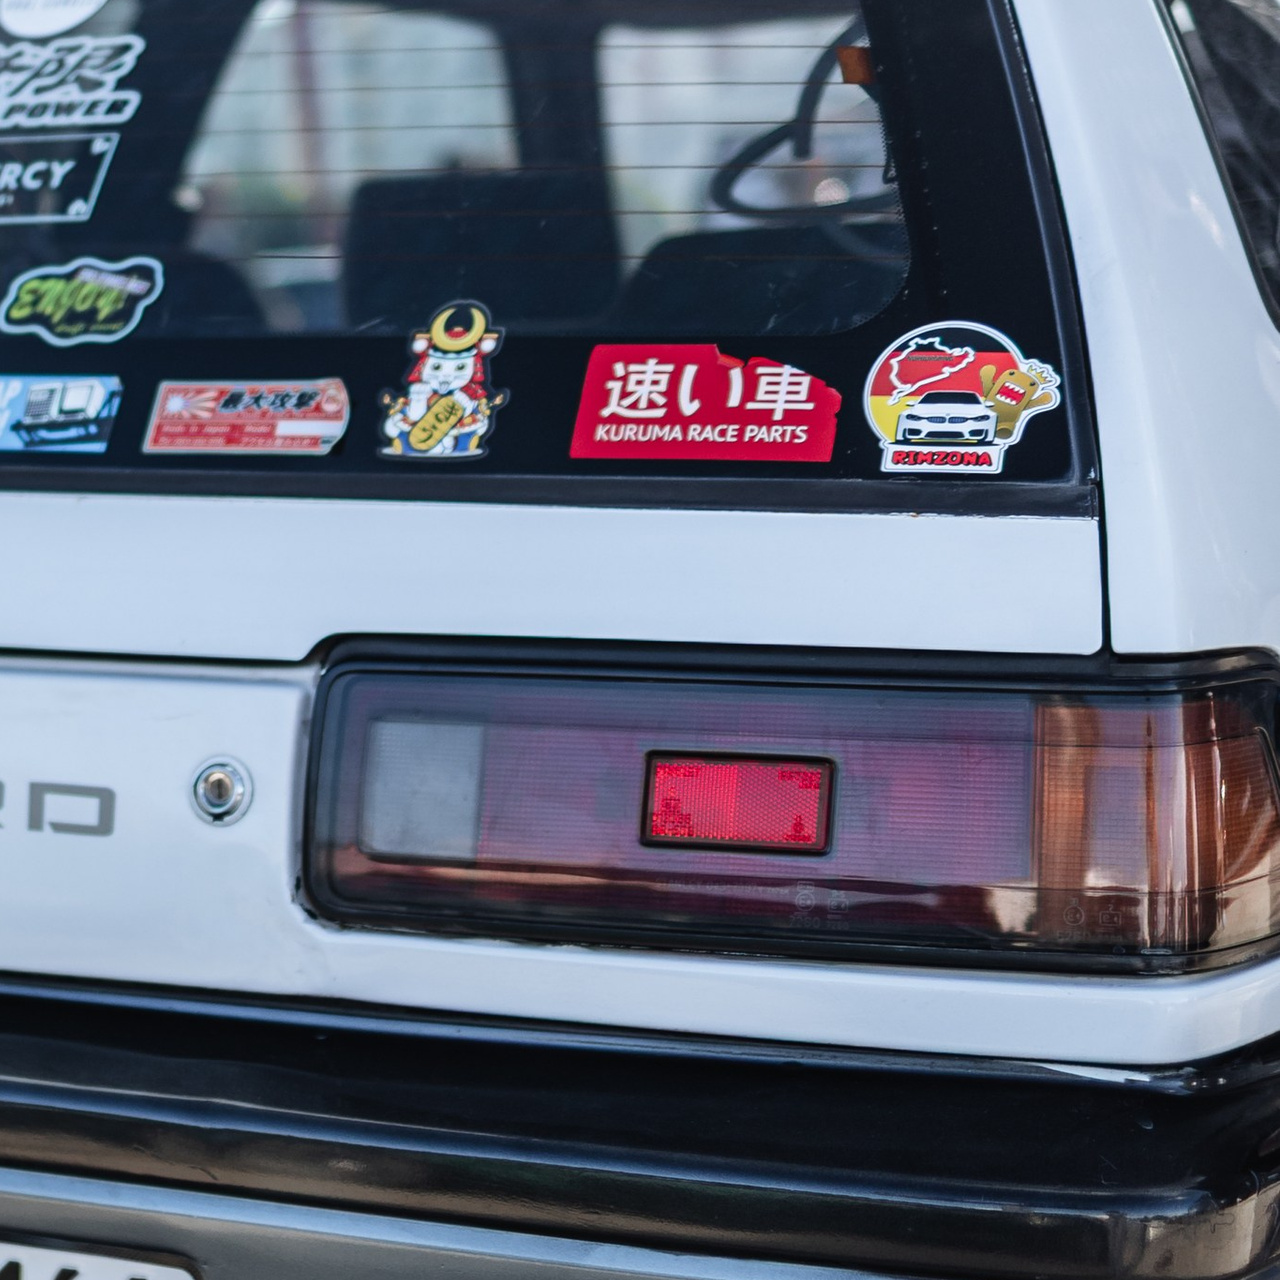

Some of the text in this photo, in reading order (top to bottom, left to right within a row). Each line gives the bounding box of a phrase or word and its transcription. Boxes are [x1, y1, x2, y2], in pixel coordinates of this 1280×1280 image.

[1, 98, 132, 120] POWER
[598, 357, 816, 422] 速い車
[595, 423, 810, 445] KURUMA RACE PARTS
[891, 449, 994, 468] RIMZONA
